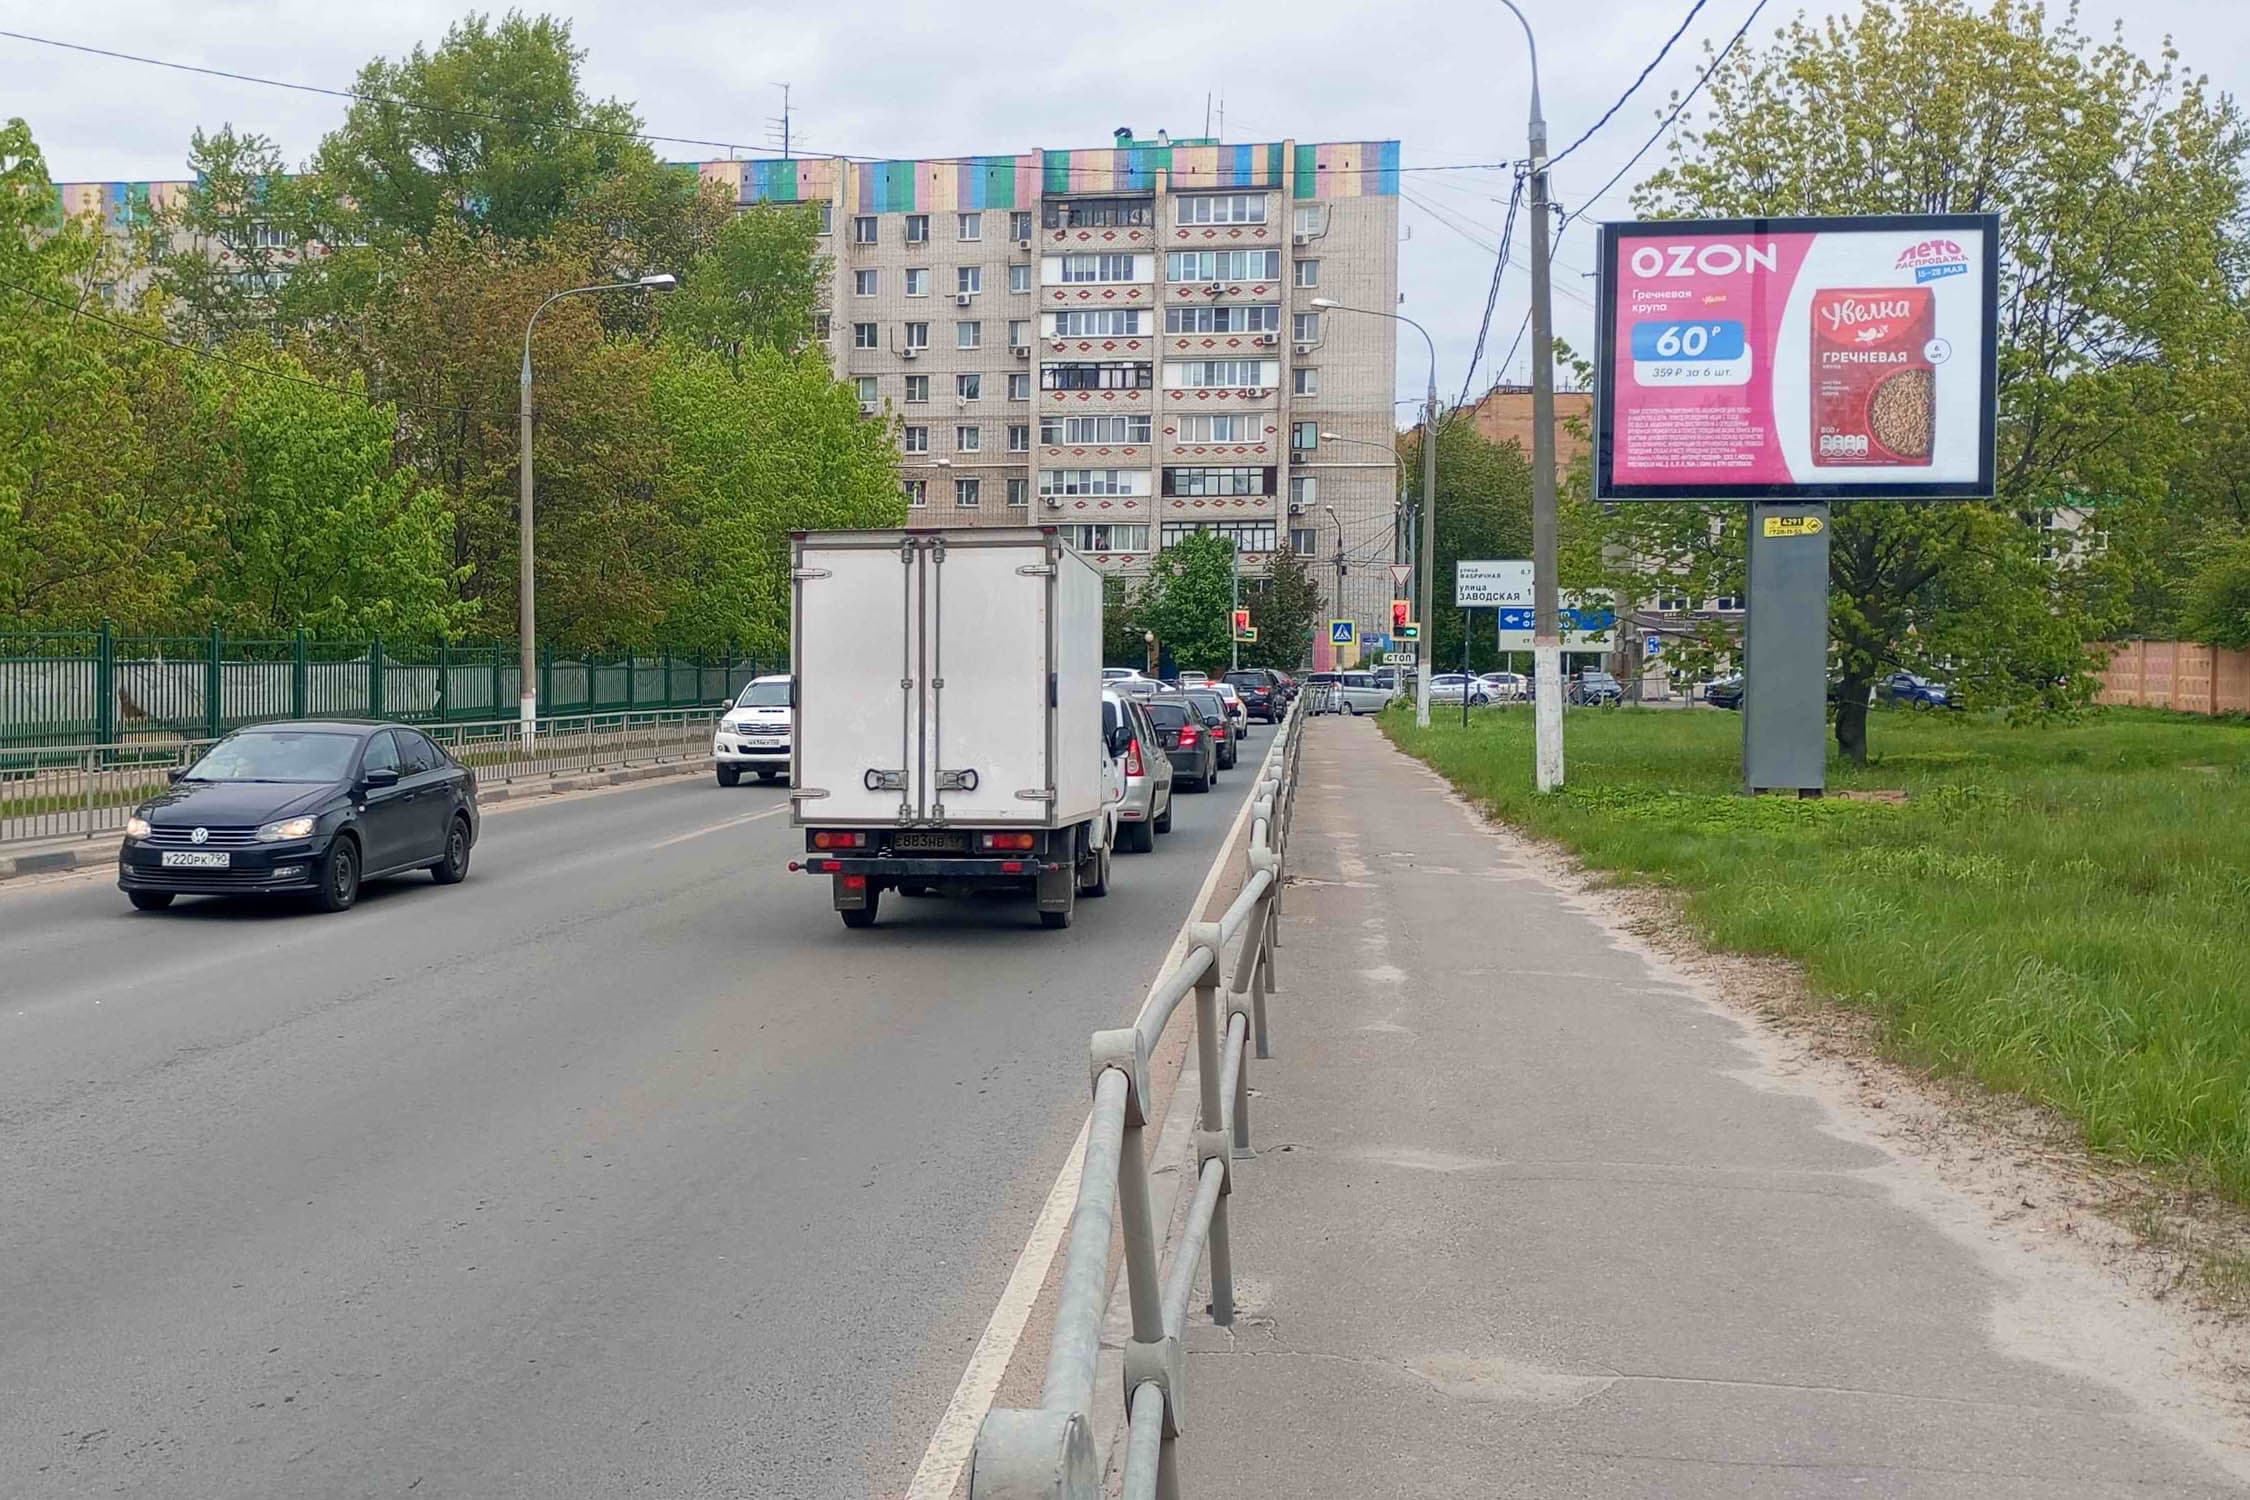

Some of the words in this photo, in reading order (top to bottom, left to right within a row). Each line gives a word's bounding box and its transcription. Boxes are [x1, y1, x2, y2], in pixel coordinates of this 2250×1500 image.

[1631, 243, 1777, 278] OZON
[1943, 264, 1965, 275] МАЯ
[1632, 289, 1692, 301] Гречневая
[1632, 303, 1668, 314] крупа
[1822, 351, 1908, 363] ГРЕЧНЕВАЯ
[1653, 368, 1673, 377] 359
[1704, 368, 1711, 377] 6
[1460, 592, 1520, 601] ЗАВОДСКАЯ
[1386, 654, 1412, 662] СТОП
